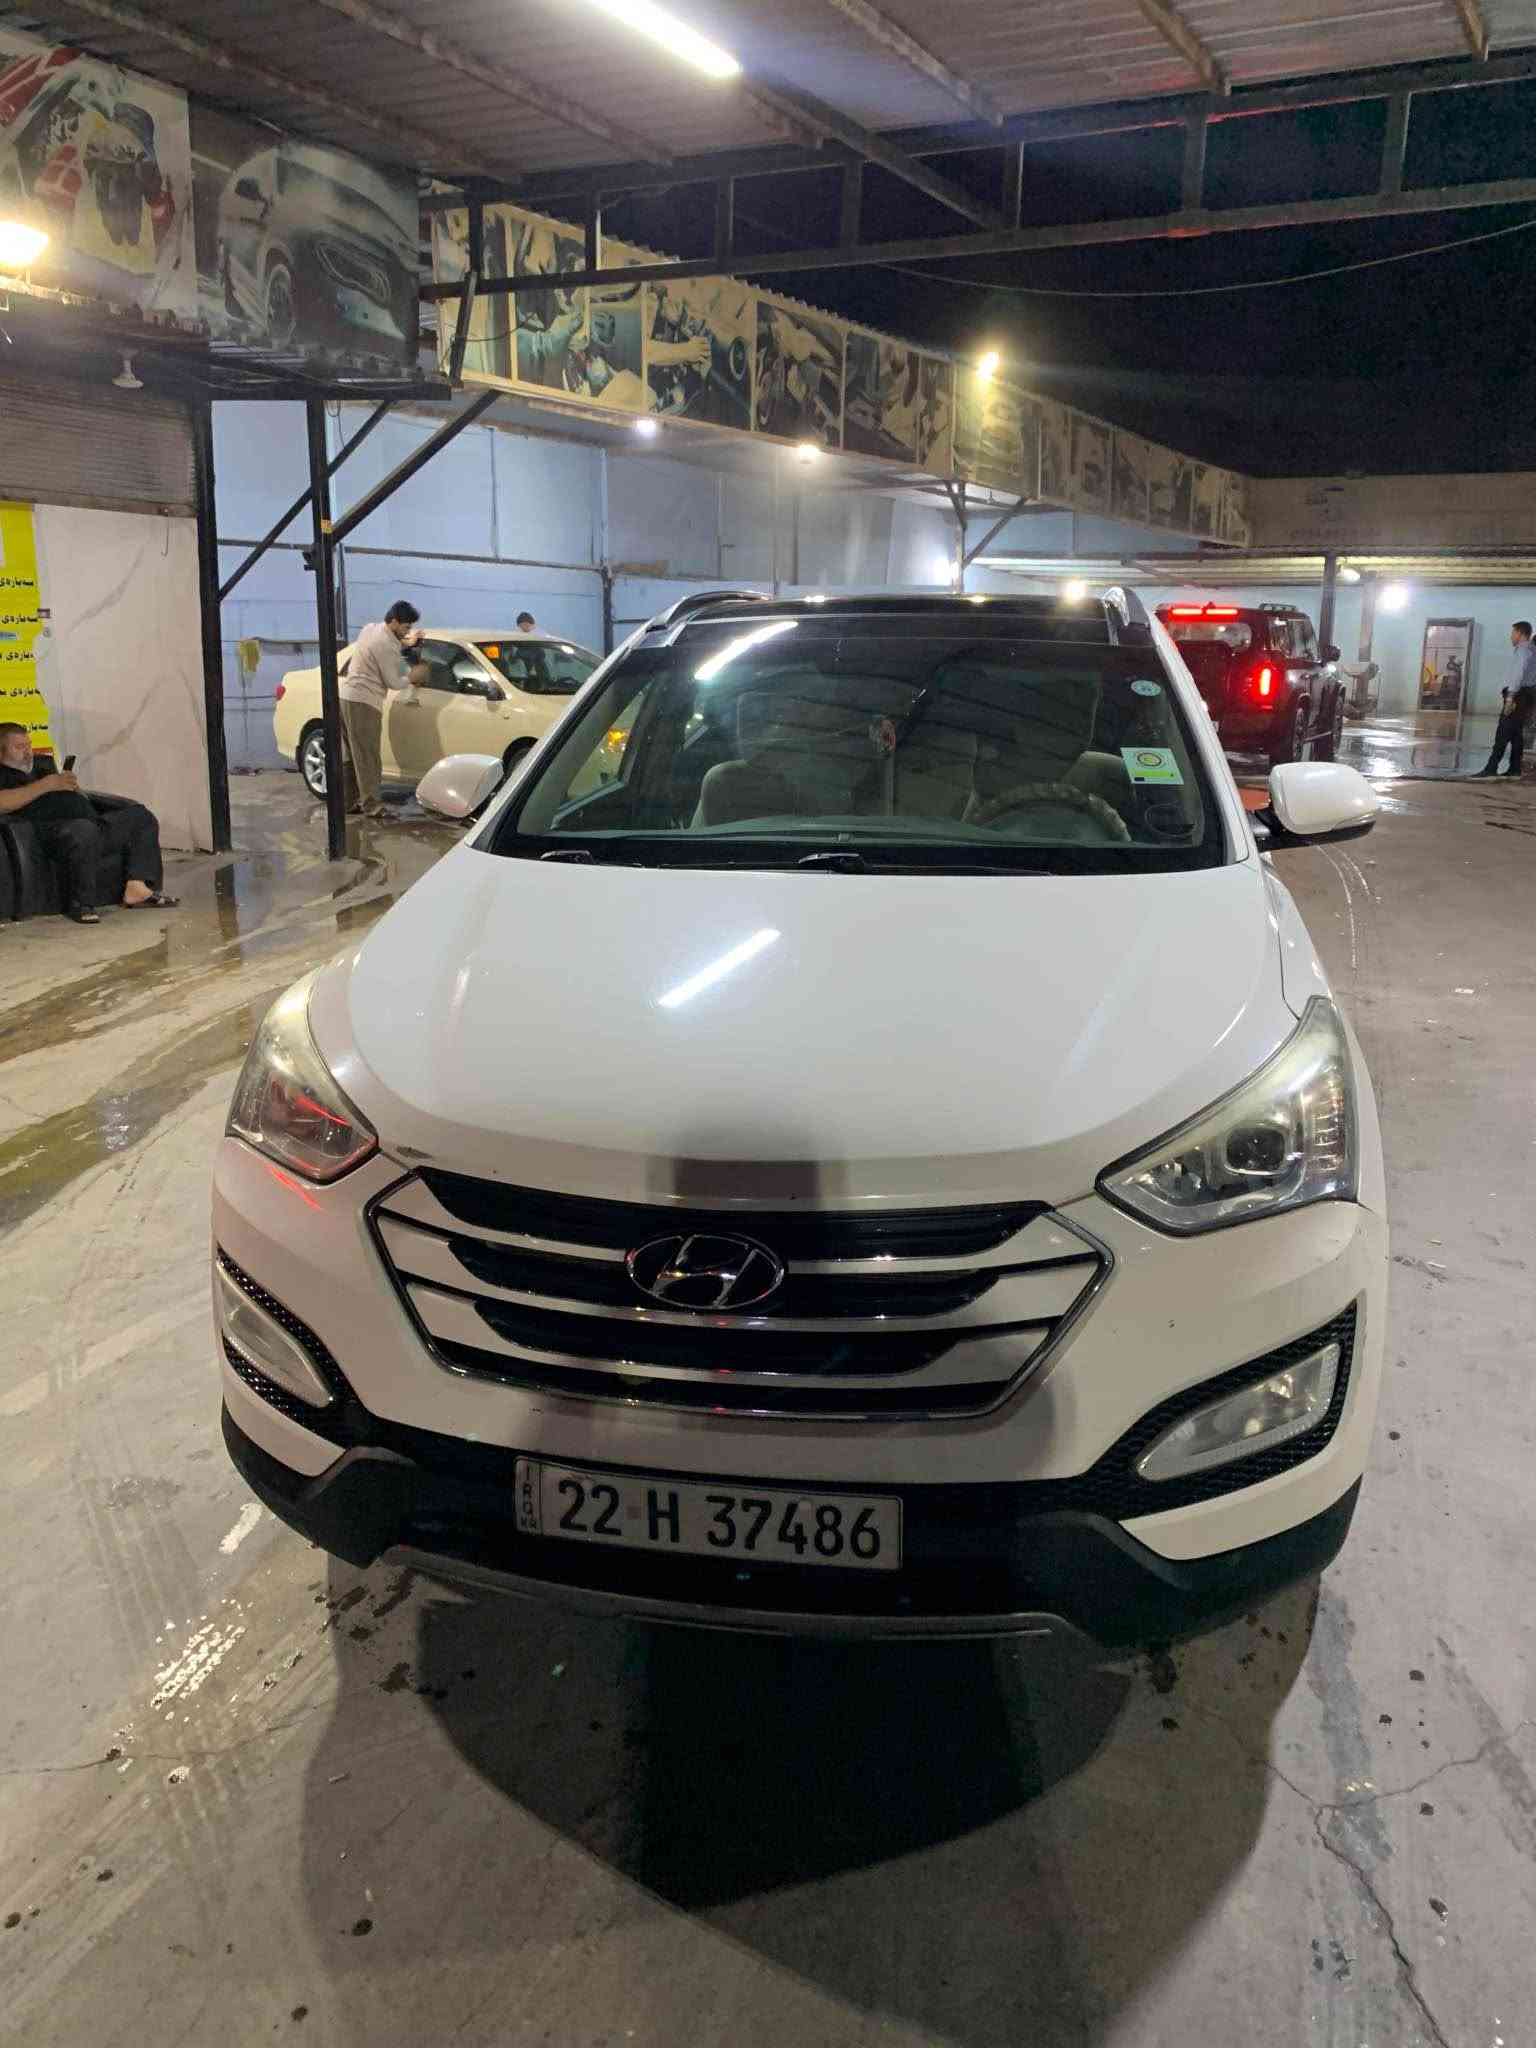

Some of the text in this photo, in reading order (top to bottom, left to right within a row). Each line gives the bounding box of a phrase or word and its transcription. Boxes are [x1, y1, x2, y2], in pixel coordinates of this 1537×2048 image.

[557, 1479, 881, 1560] 22 H 37486
